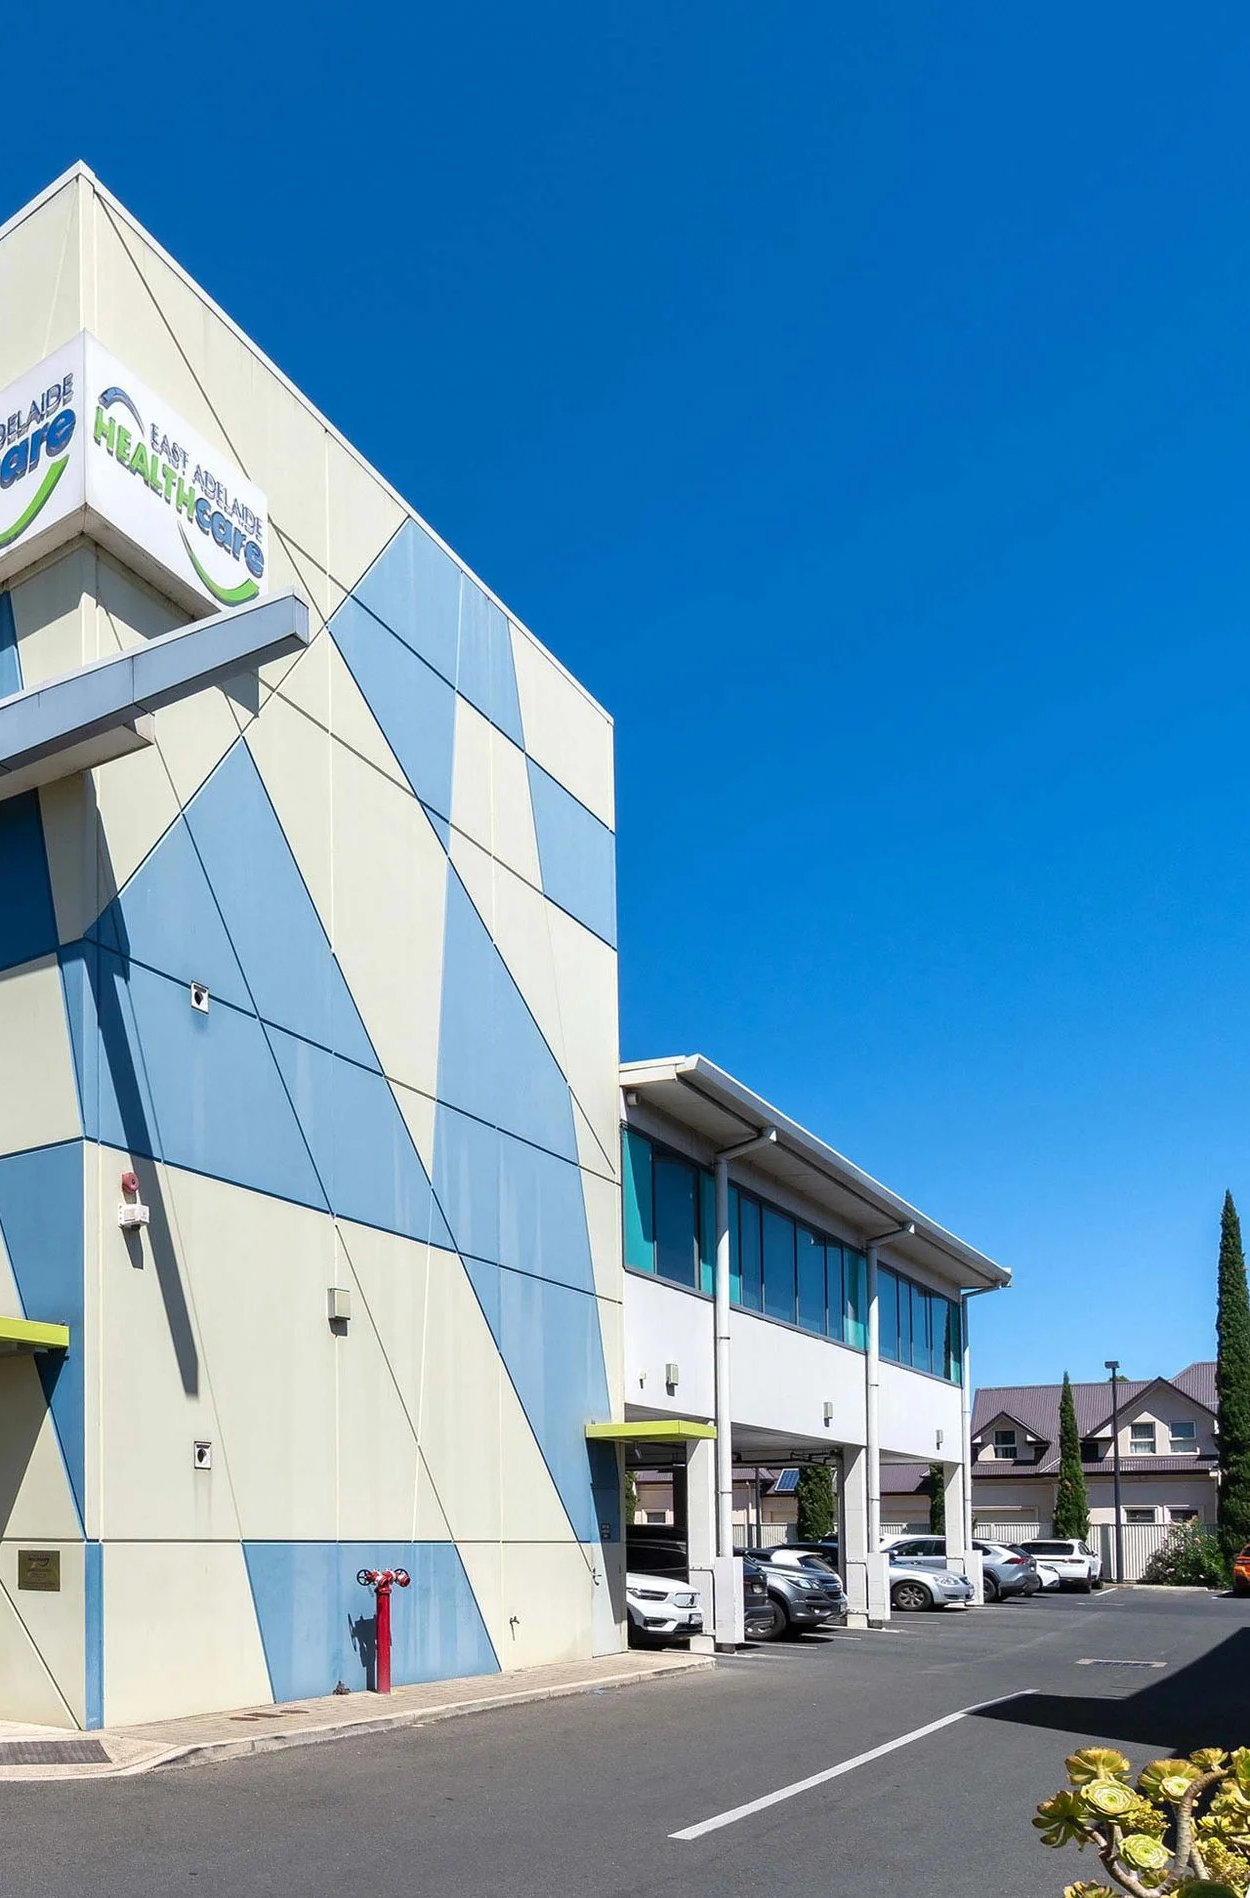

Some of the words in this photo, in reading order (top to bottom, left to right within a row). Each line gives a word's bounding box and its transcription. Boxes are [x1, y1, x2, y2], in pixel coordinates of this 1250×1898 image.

[94, 406, 265, 579] HEALTHcare
[150, 423, 189, 474] EAST
[192, 464, 263, 542] ADELAIDE
